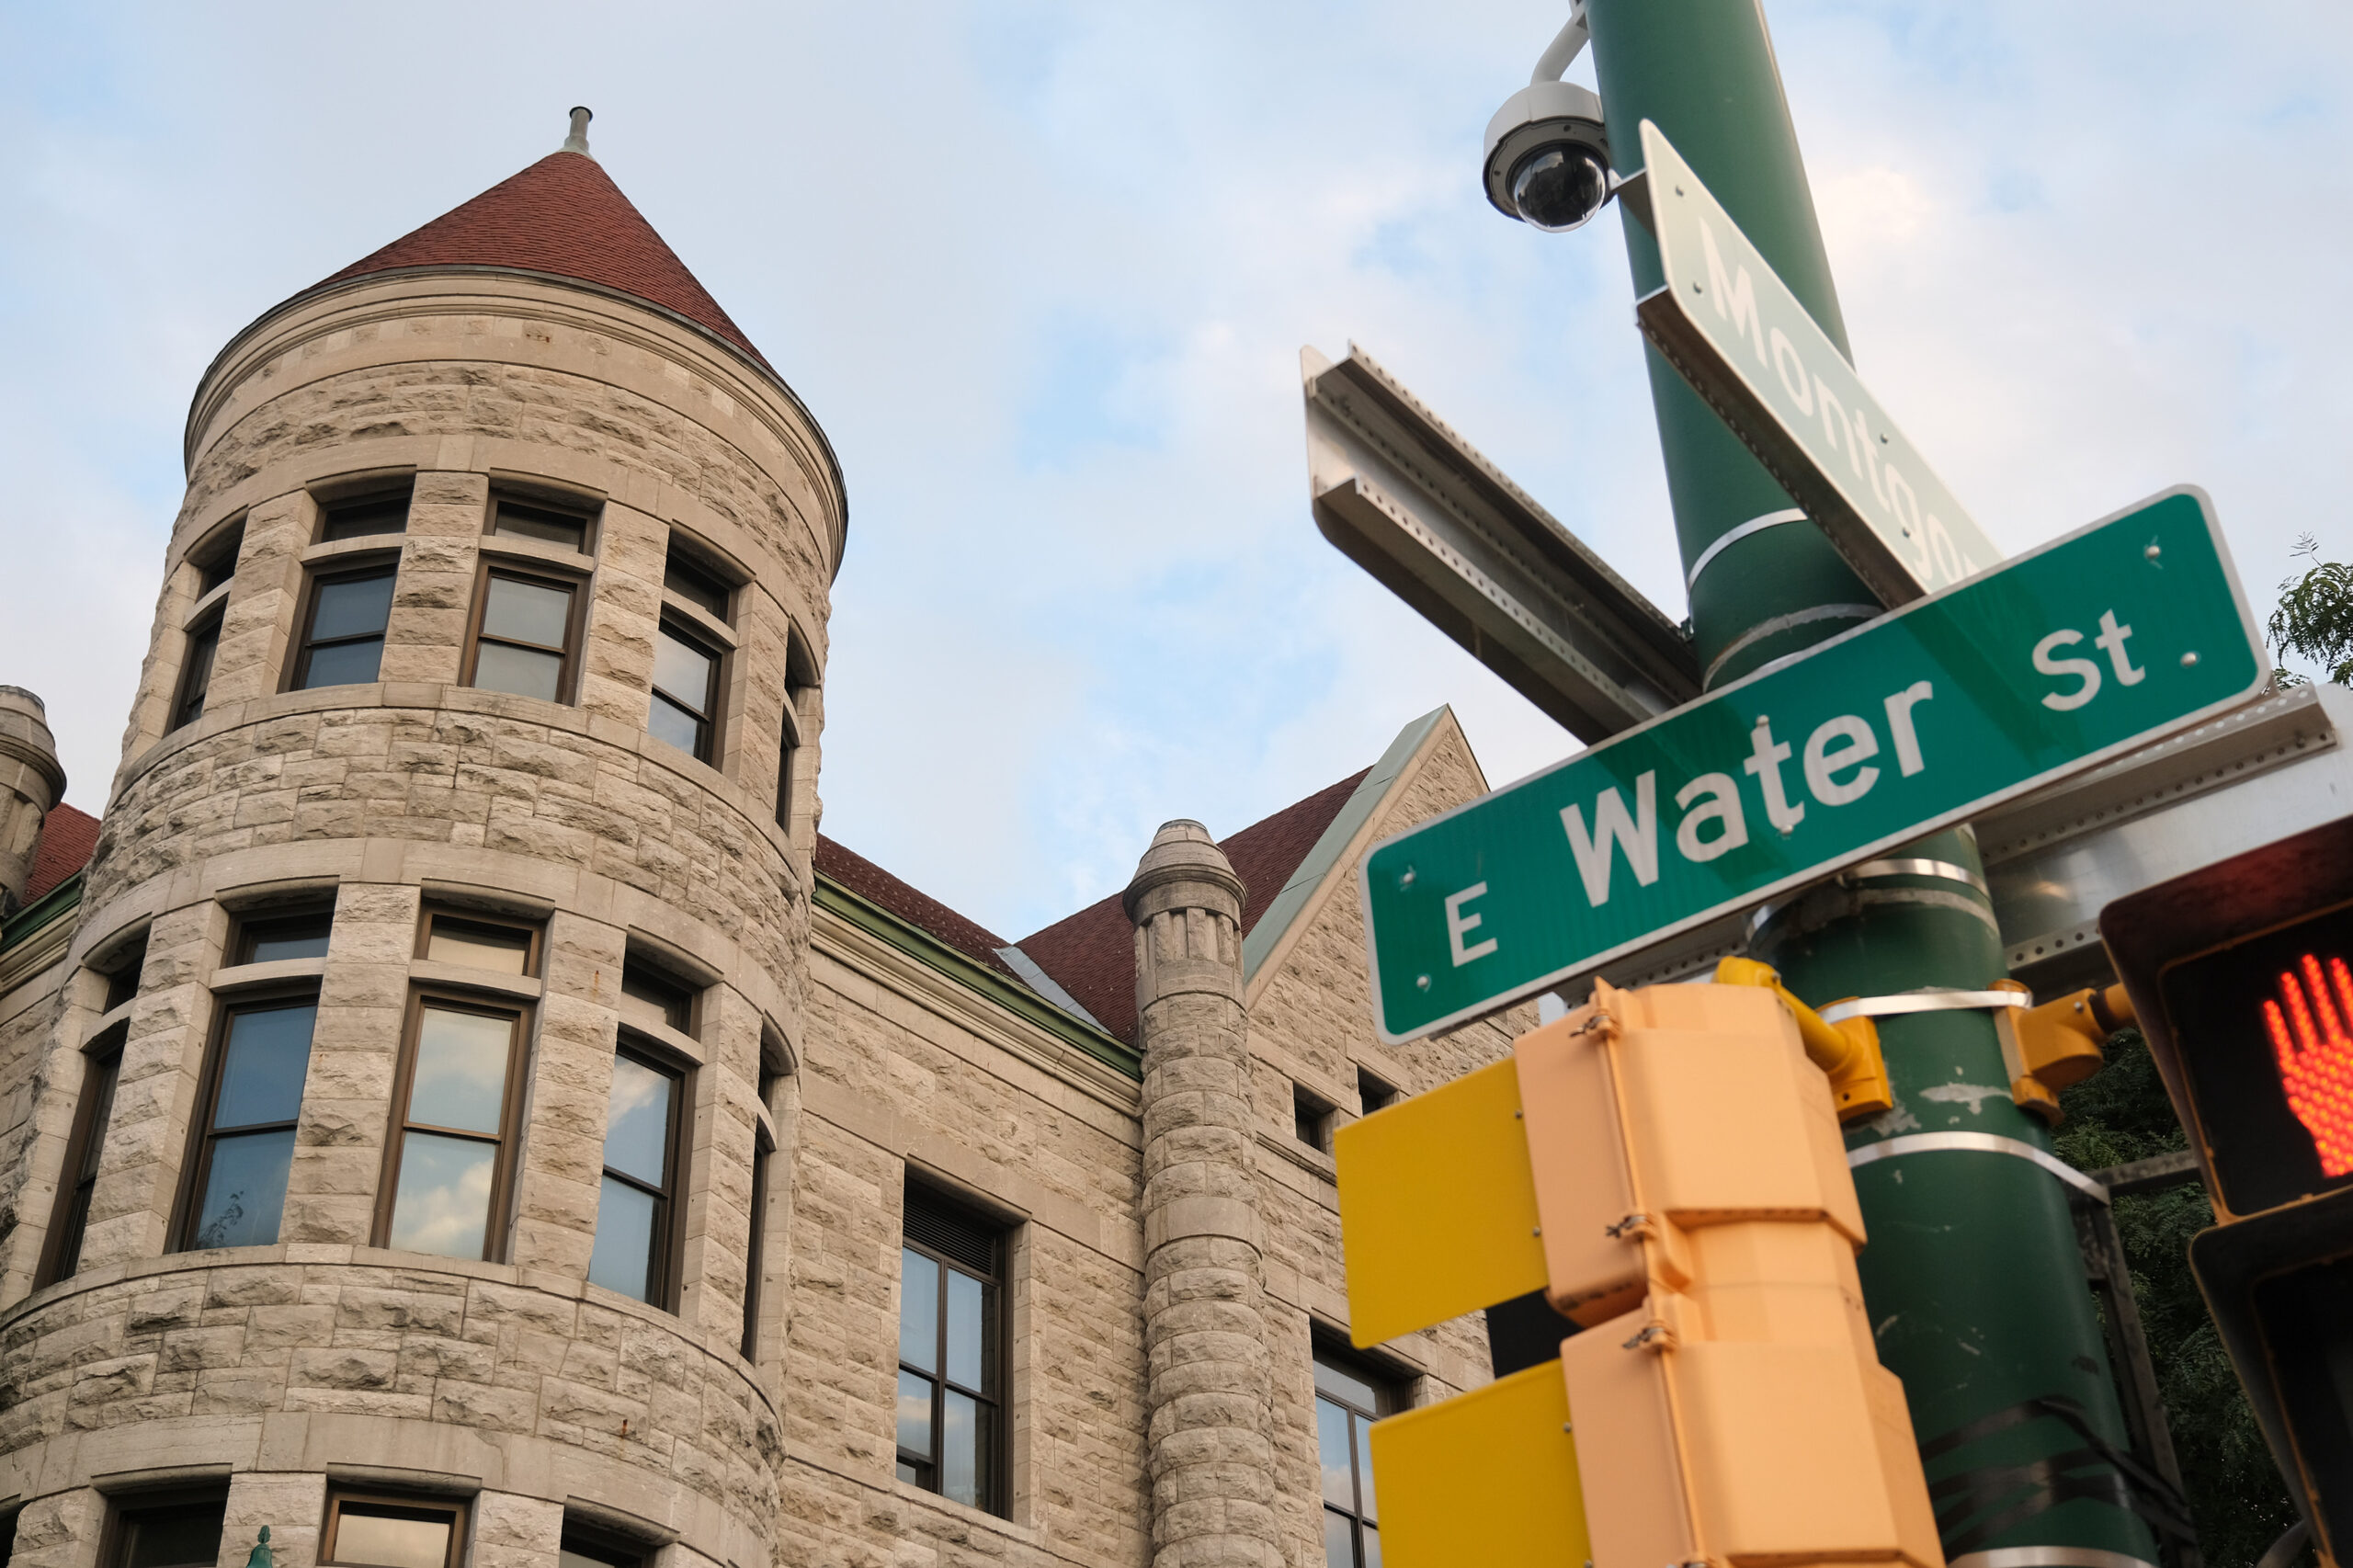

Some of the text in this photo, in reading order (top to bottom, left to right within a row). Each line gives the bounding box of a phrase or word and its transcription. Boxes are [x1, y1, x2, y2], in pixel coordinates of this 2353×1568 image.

[1699, 216, 1981, 585] Montgo
[1444, 608, 2146, 968] E Water St
